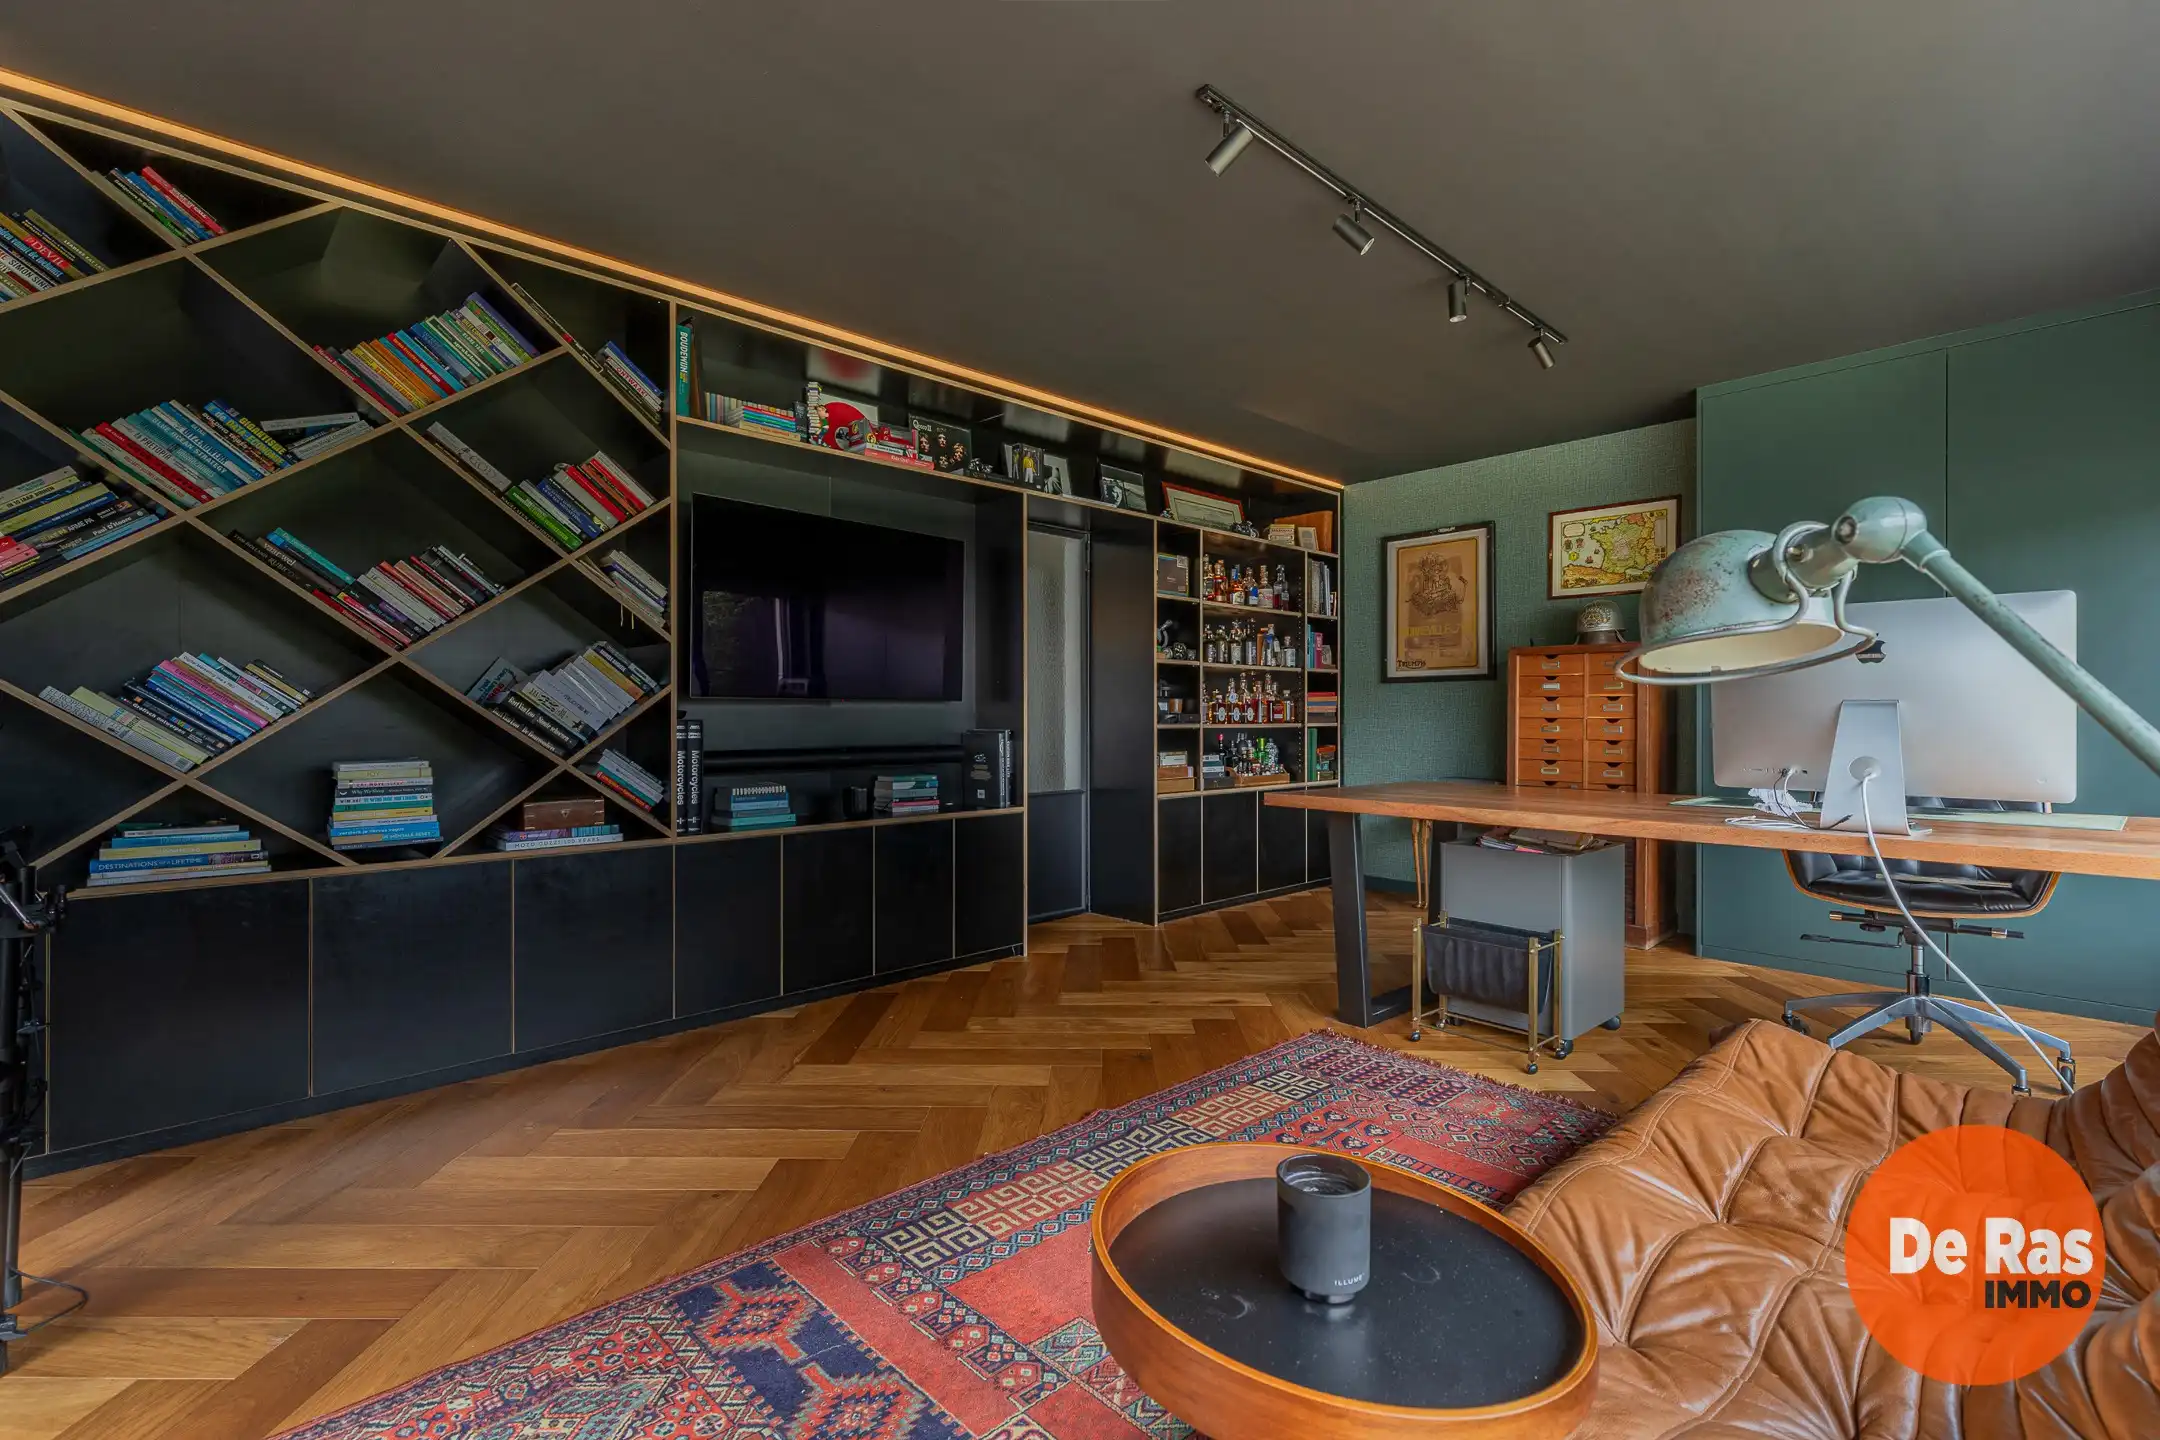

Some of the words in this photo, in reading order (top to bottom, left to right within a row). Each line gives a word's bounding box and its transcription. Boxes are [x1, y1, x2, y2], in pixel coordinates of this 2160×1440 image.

[31, 238, 65, 267] DEVIL
[8, 260, 34, 280] SIMON
[152, 417, 172, 433] BLUE
[171, 430, 193, 450] OCEAN
[194, 449, 227, 474] STRATEGY
[92, 525, 108, 537] Paul
[48, 687, 93, 715] EUROPEAN
[132, 702, 156, 719] Grafisch
[155, 715, 187, 735] ontwerpen
[677, 750, 686, 806] Motorcycles
[689, 750, 700, 805] Motorcycles
[98, 860, 158, 871] DESTINATIONS
[171, 857, 203, 866] LIFETIME
[1334, 1275, 1363, 1287] ILLUME
